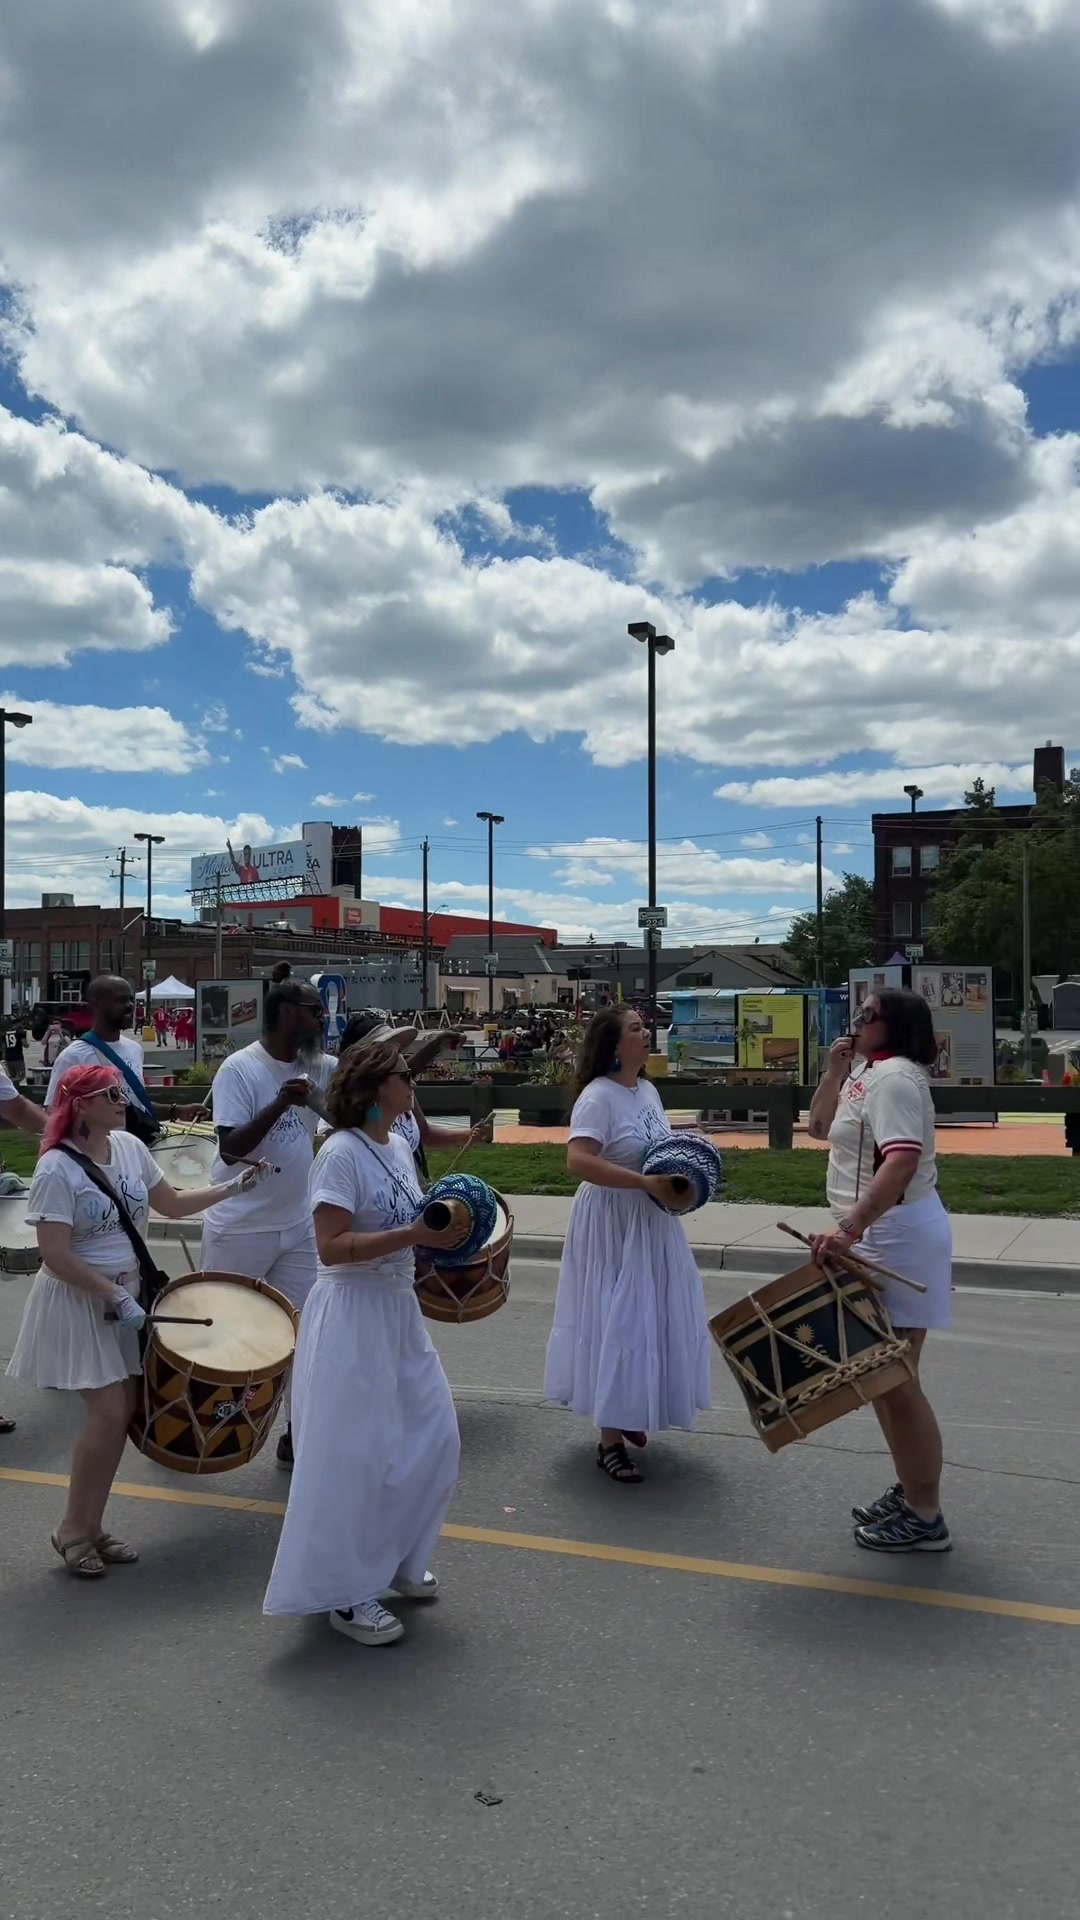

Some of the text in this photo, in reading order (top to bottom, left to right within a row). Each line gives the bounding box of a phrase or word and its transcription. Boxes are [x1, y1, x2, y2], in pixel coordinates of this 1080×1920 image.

[253, 849, 294, 869] ULTRA
[273, 866, 294, 875] ZERO
[5, 1034, 17, 1048] 19
